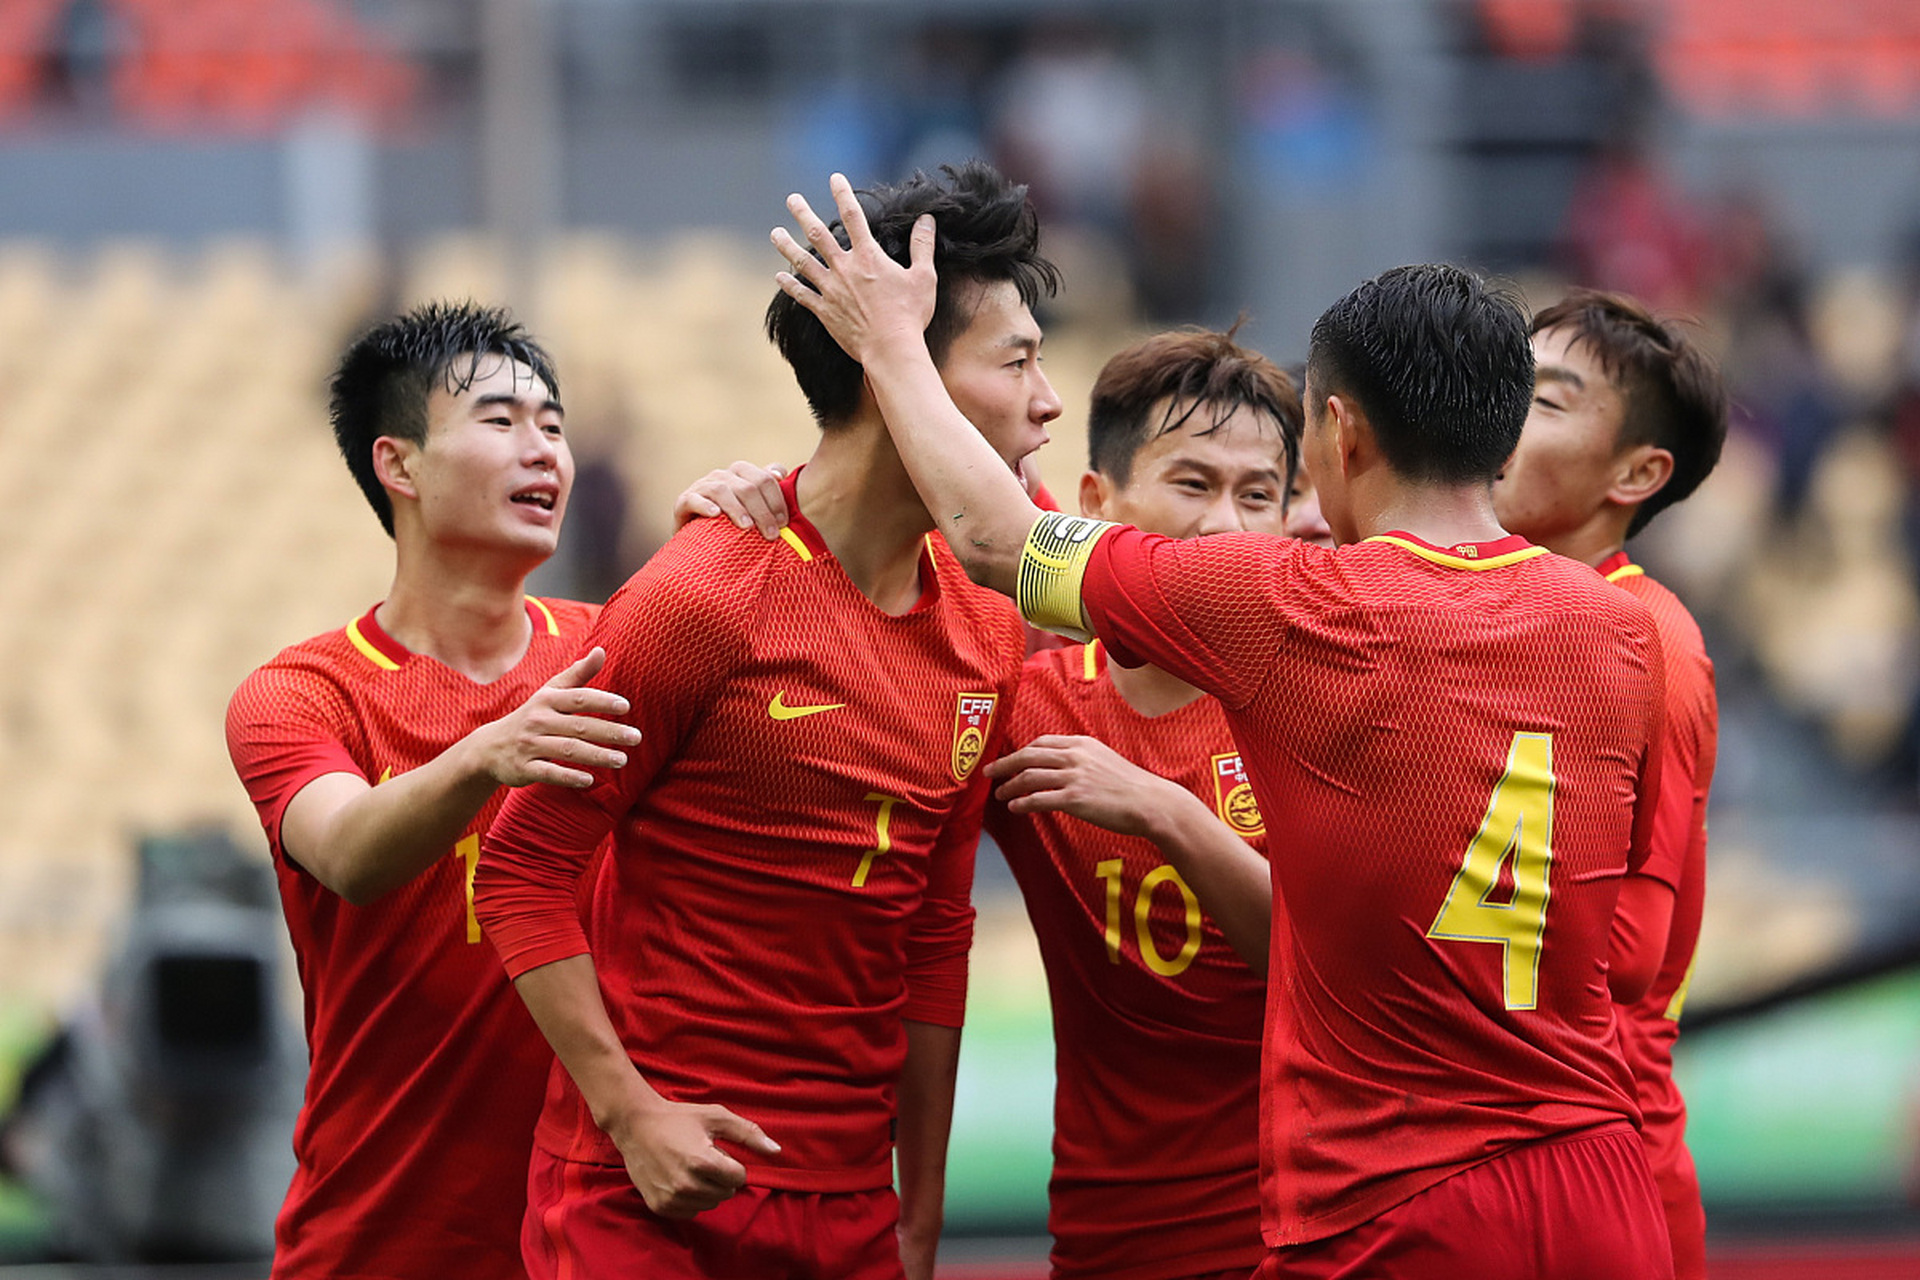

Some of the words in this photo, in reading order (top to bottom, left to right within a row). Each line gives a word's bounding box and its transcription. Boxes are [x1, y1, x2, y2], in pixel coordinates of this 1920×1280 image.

[1456, 545, 1478, 558] 中国
[960, 699, 993, 714] CFA
[851, 792, 908, 888] 7
[1426, 731, 1556, 1010] 4
[1096, 858, 1202, 977] 10
